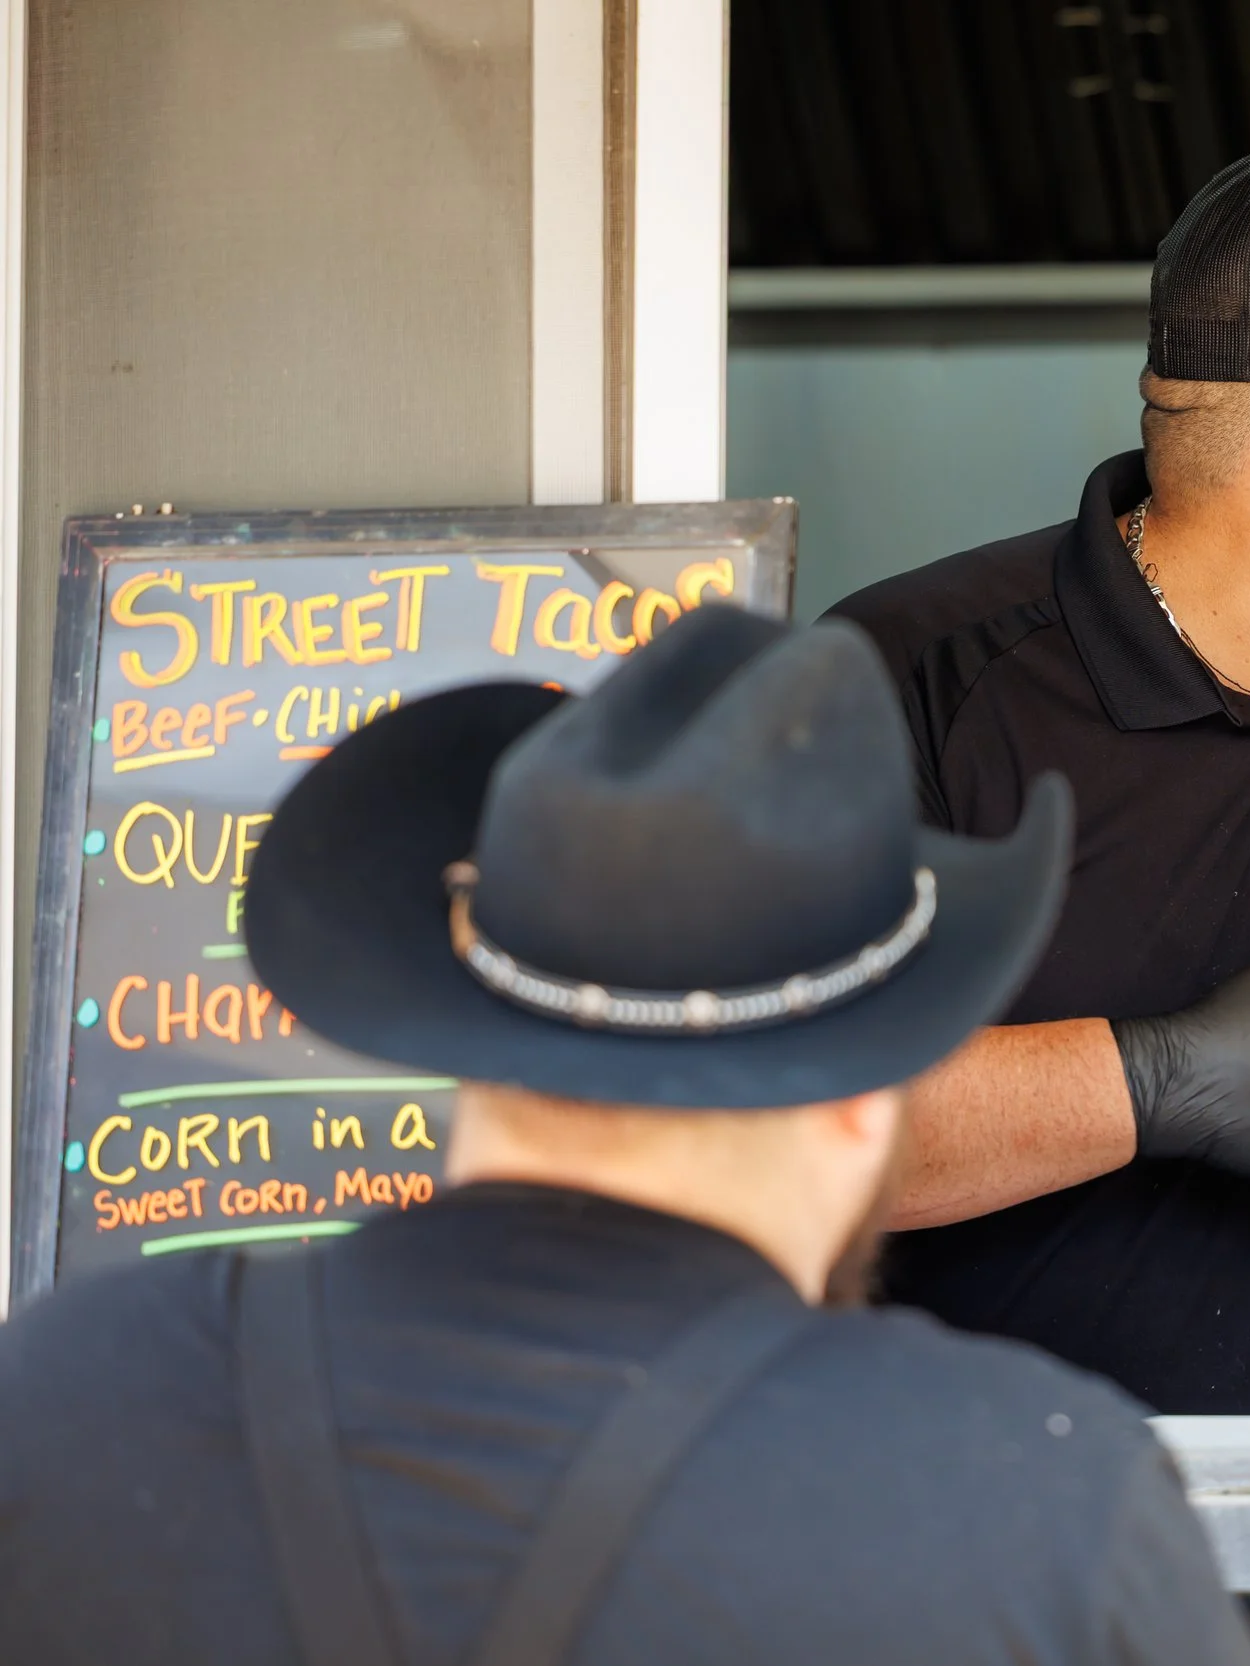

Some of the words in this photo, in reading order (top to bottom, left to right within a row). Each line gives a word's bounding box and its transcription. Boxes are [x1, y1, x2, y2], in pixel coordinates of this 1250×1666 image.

[110, 564, 450, 688] STREET
[311, 1107, 365, 1150] in
[390, 1103, 436, 1150] a
[335, 1167, 434, 1211] Mayo
